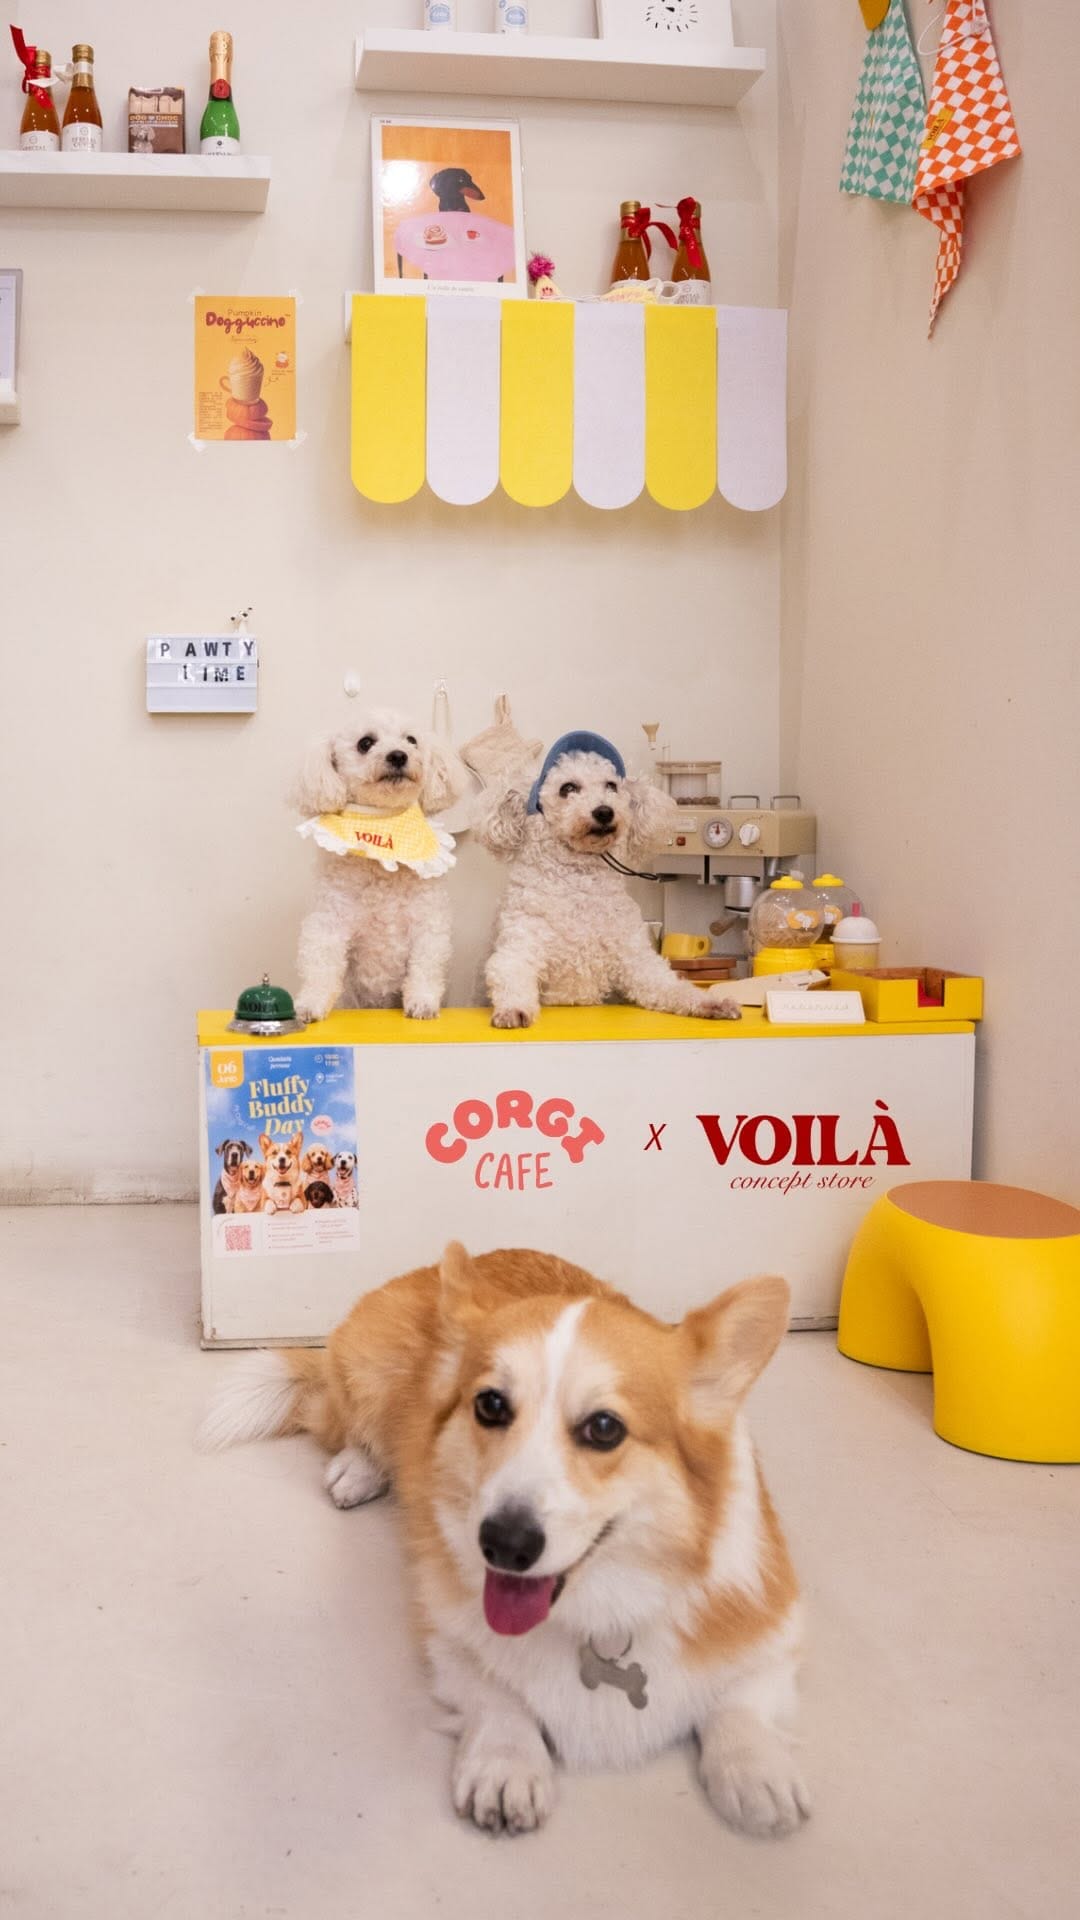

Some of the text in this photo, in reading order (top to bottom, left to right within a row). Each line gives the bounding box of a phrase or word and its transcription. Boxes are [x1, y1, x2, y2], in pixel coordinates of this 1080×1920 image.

[160, 641, 254, 657] PAWTY
[217, 1061, 238, 1075] 06
[249, 1075, 310, 1099] Fluffy
[248, 1093, 315, 1119] Buddy
[265, 1118, 304, 1137] Day
[425, 1090, 605, 1164] CORGI
[696, 1099, 910, 1166] VOILÀ
[475, 1152, 554, 1191] CAFE
[730, 1170, 876, 1195] concept store
